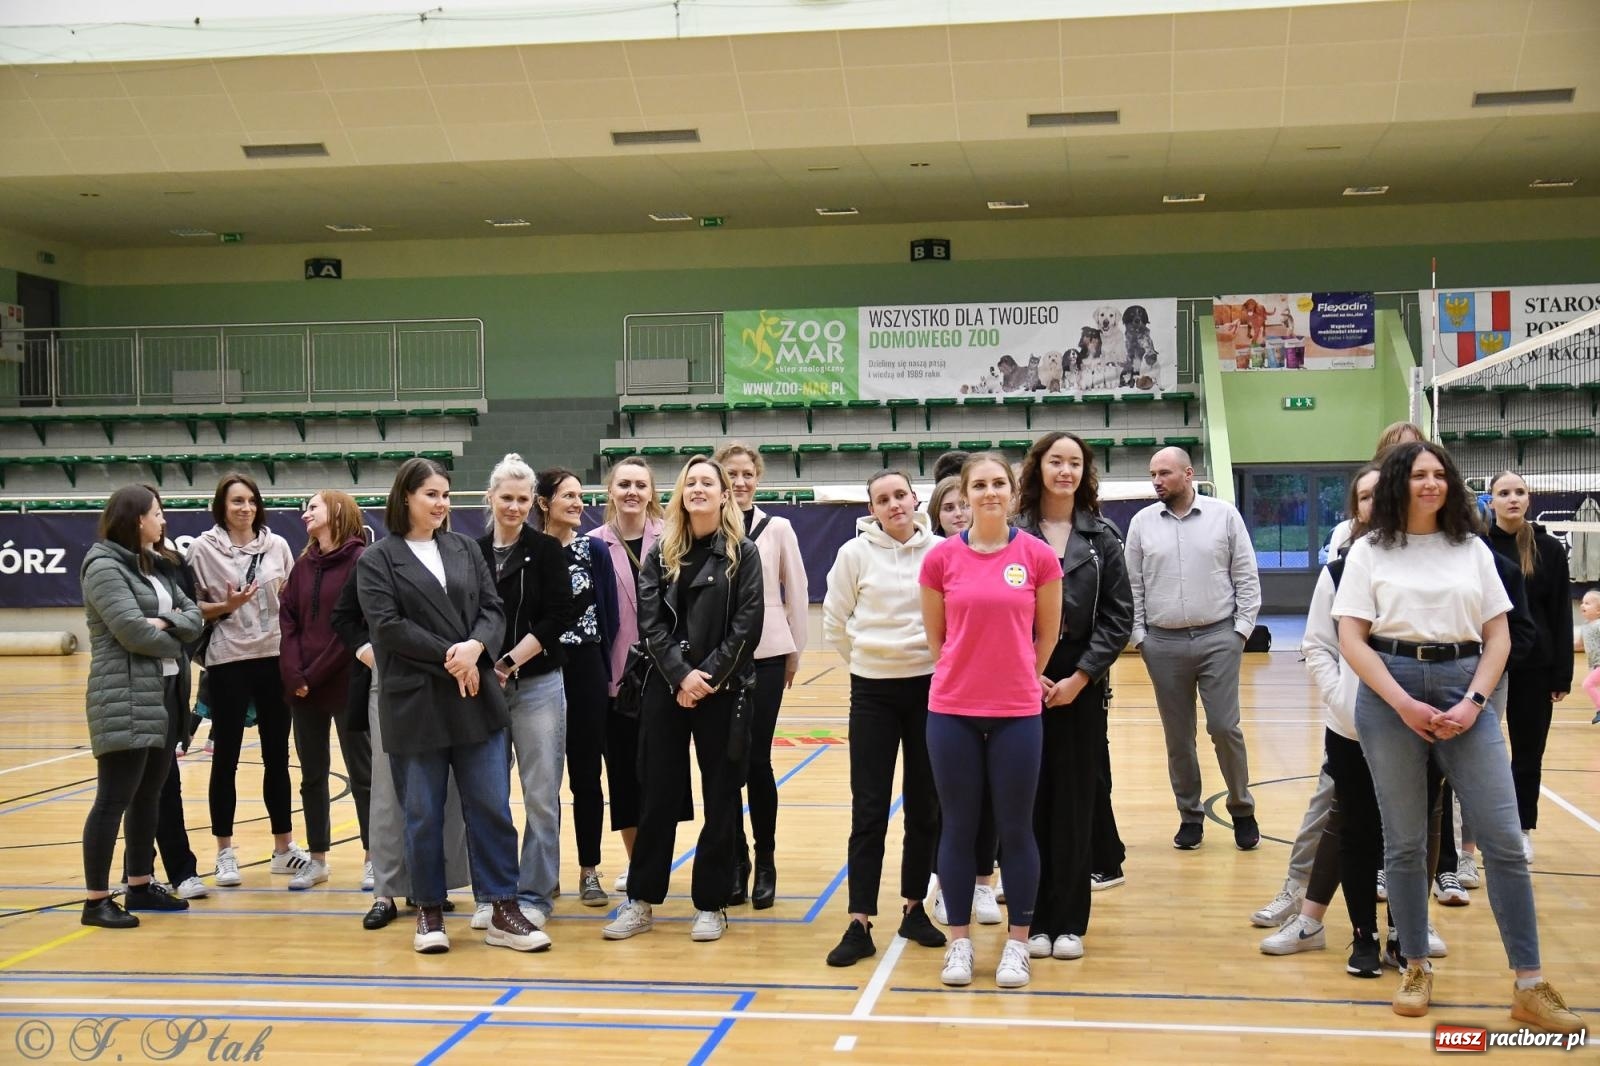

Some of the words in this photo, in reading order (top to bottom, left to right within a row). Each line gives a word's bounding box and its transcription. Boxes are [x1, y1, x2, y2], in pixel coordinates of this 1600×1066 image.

[914, 246, 925, 259] B
[933, 245, 946, 258] B
[306, 265, 315, 278] A
[320, 264, 338, 277] A
[1317, 302, 1368, 312] Flexadin
[868, 308, 950, 328] WSZYSTKO
[955, 307, 984, 326] DLA
[989, 305, 1059, 326] TWOJEGO
[780, 320, 846, 342] ZOO
[868, 330, 963, 349] DOMOWEGO
[967, 328, 1000, 347] ZOO
[775, 342, 844, 364] MAR
[775, 366, 797, 374] sklep
[799, 365, 845, 374] zoologiczny
[907, 369, 923, 378] 1989
[743, 381, 846, 396] WWW.ZOO-MAR.PL
[0, 539, 67, 574] ÓRZ
